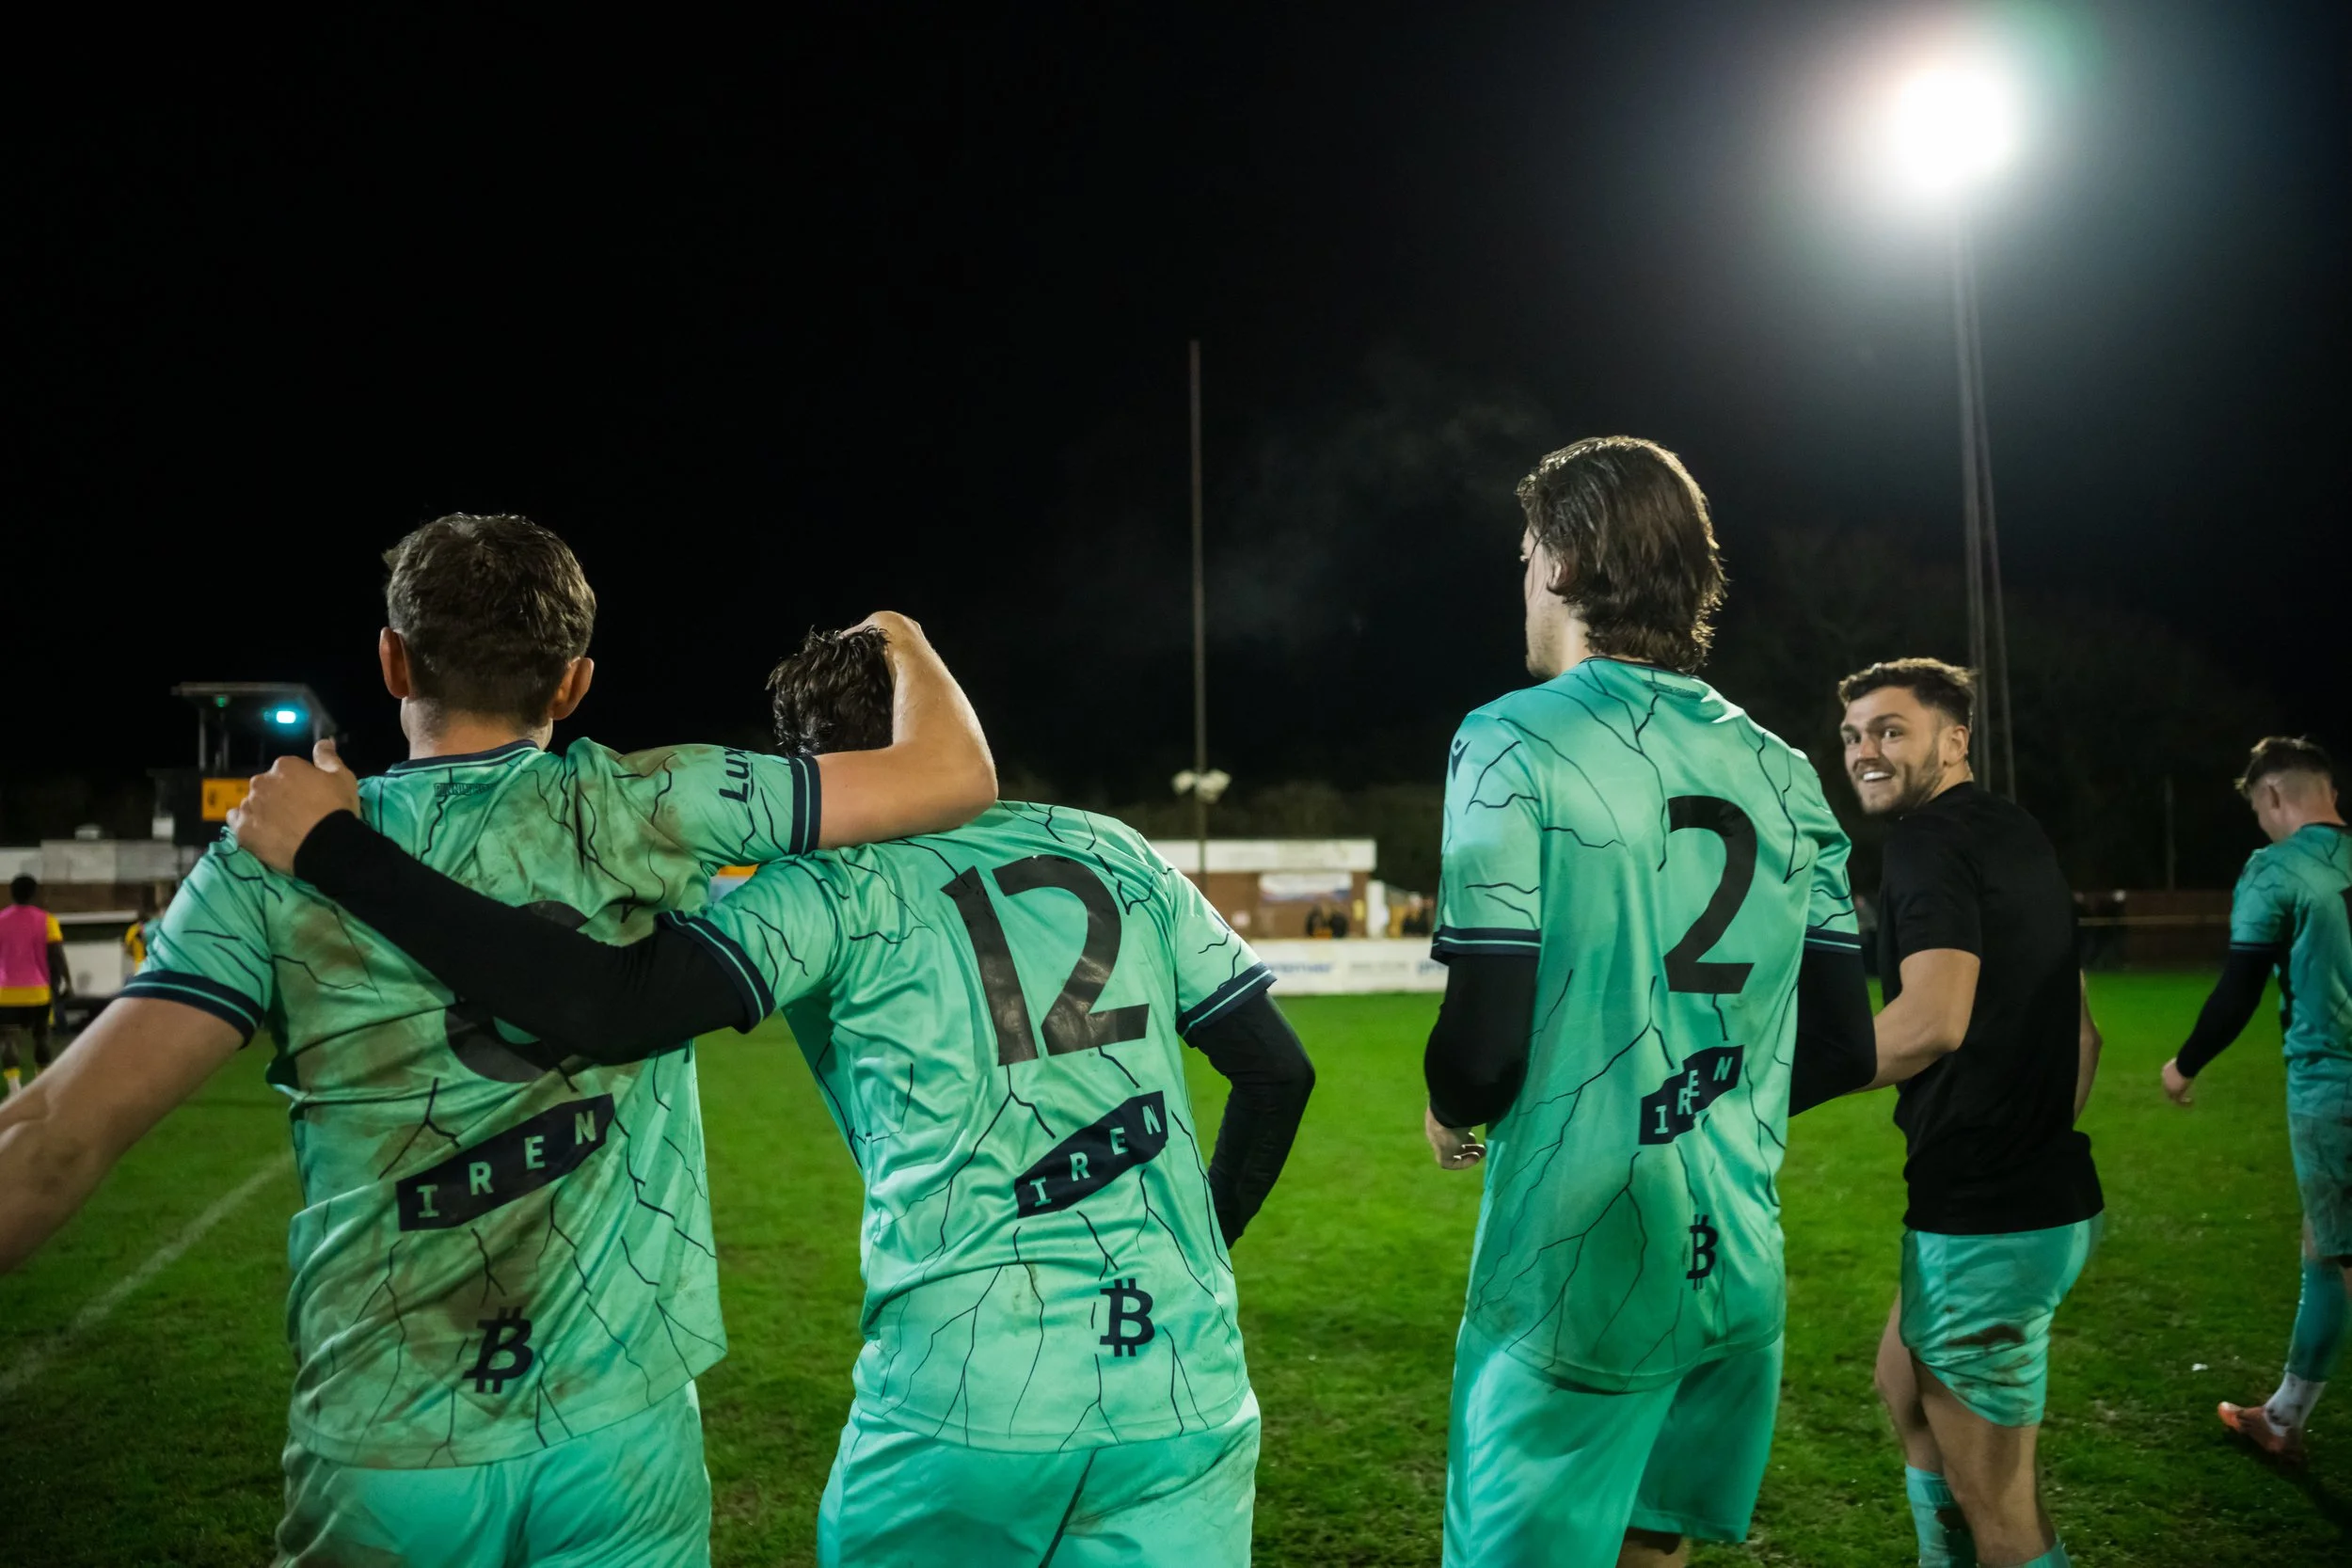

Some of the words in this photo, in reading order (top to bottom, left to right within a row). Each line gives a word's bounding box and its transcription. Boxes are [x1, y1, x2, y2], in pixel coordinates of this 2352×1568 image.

[1663, 795, 1758, 994] 2
[940, 854, 1150, 1067] 12
[1654, 1056, 1734, 1134] IREN
[416, 1109, 597, 1219] IREN
[1029, 1103, 1162, 1208] IREN
